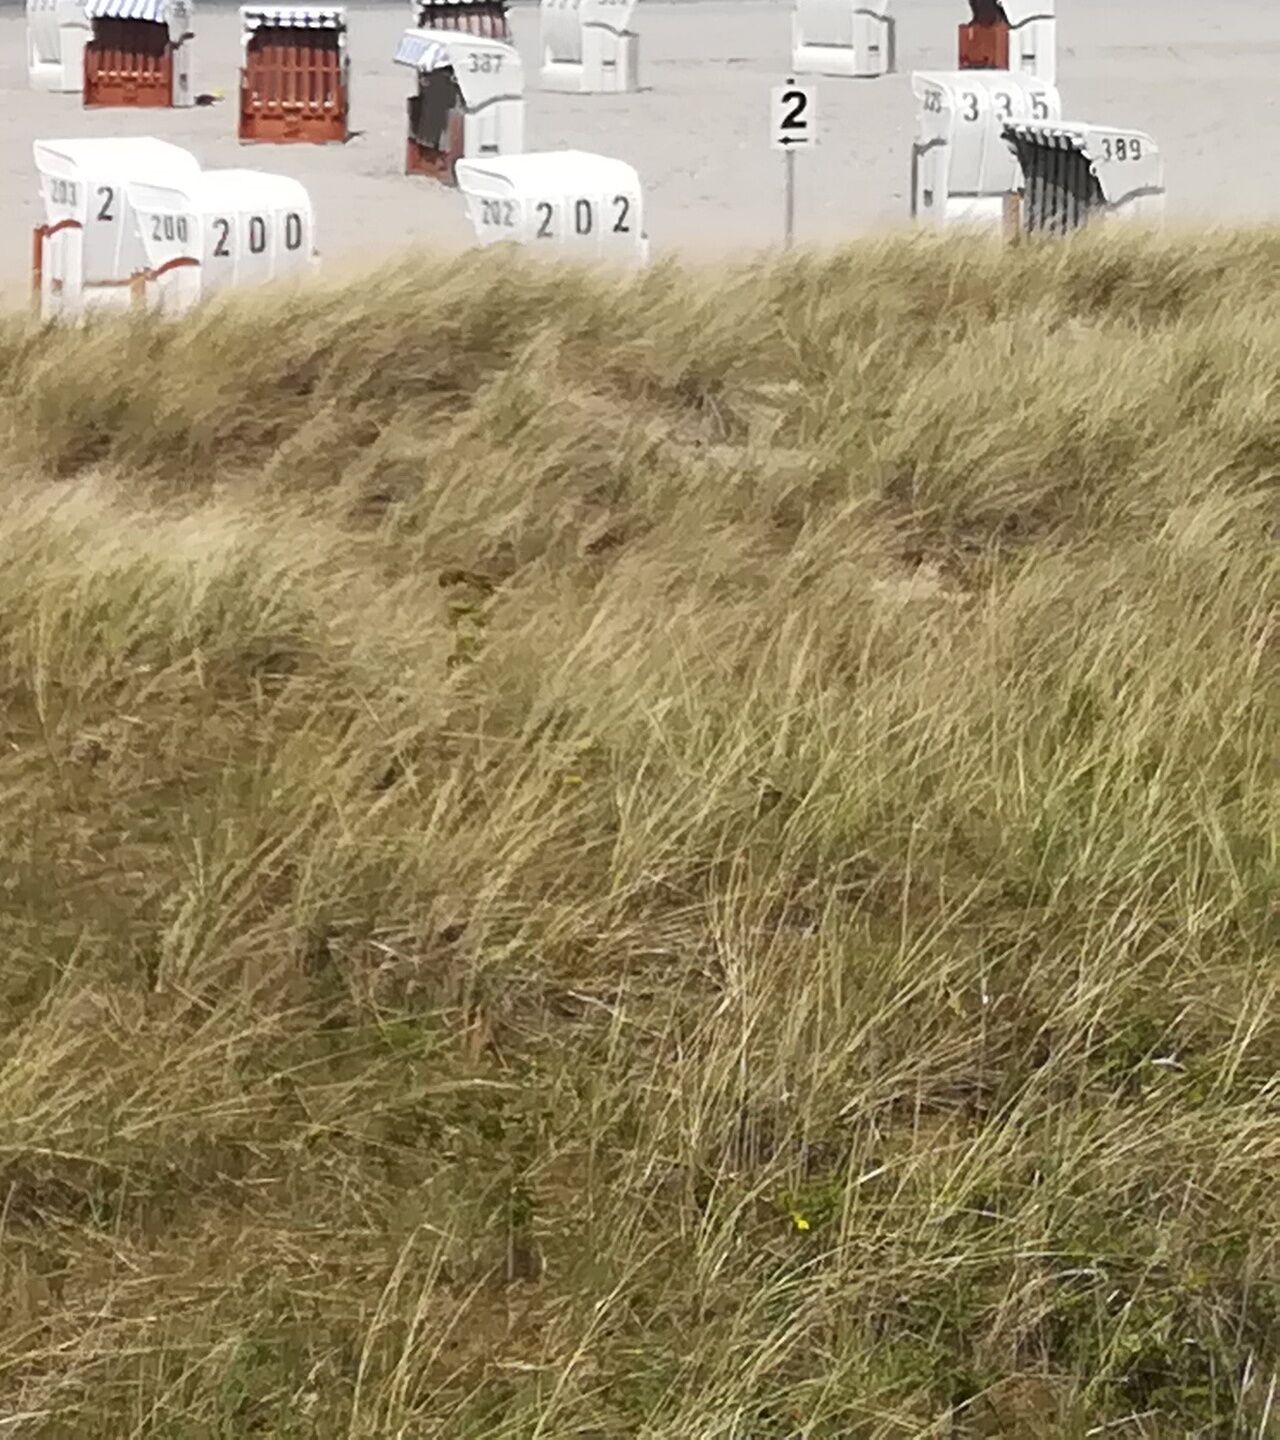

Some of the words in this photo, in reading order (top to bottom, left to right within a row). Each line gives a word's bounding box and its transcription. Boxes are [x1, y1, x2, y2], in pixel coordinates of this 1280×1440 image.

[780, 90, 808, 130] 2
[1101, 138, 1142, 161] 389
[151, 214, 188, 243] 200
[212, 212, 303, 258] 200
[536, 195, 630, 239] 202
